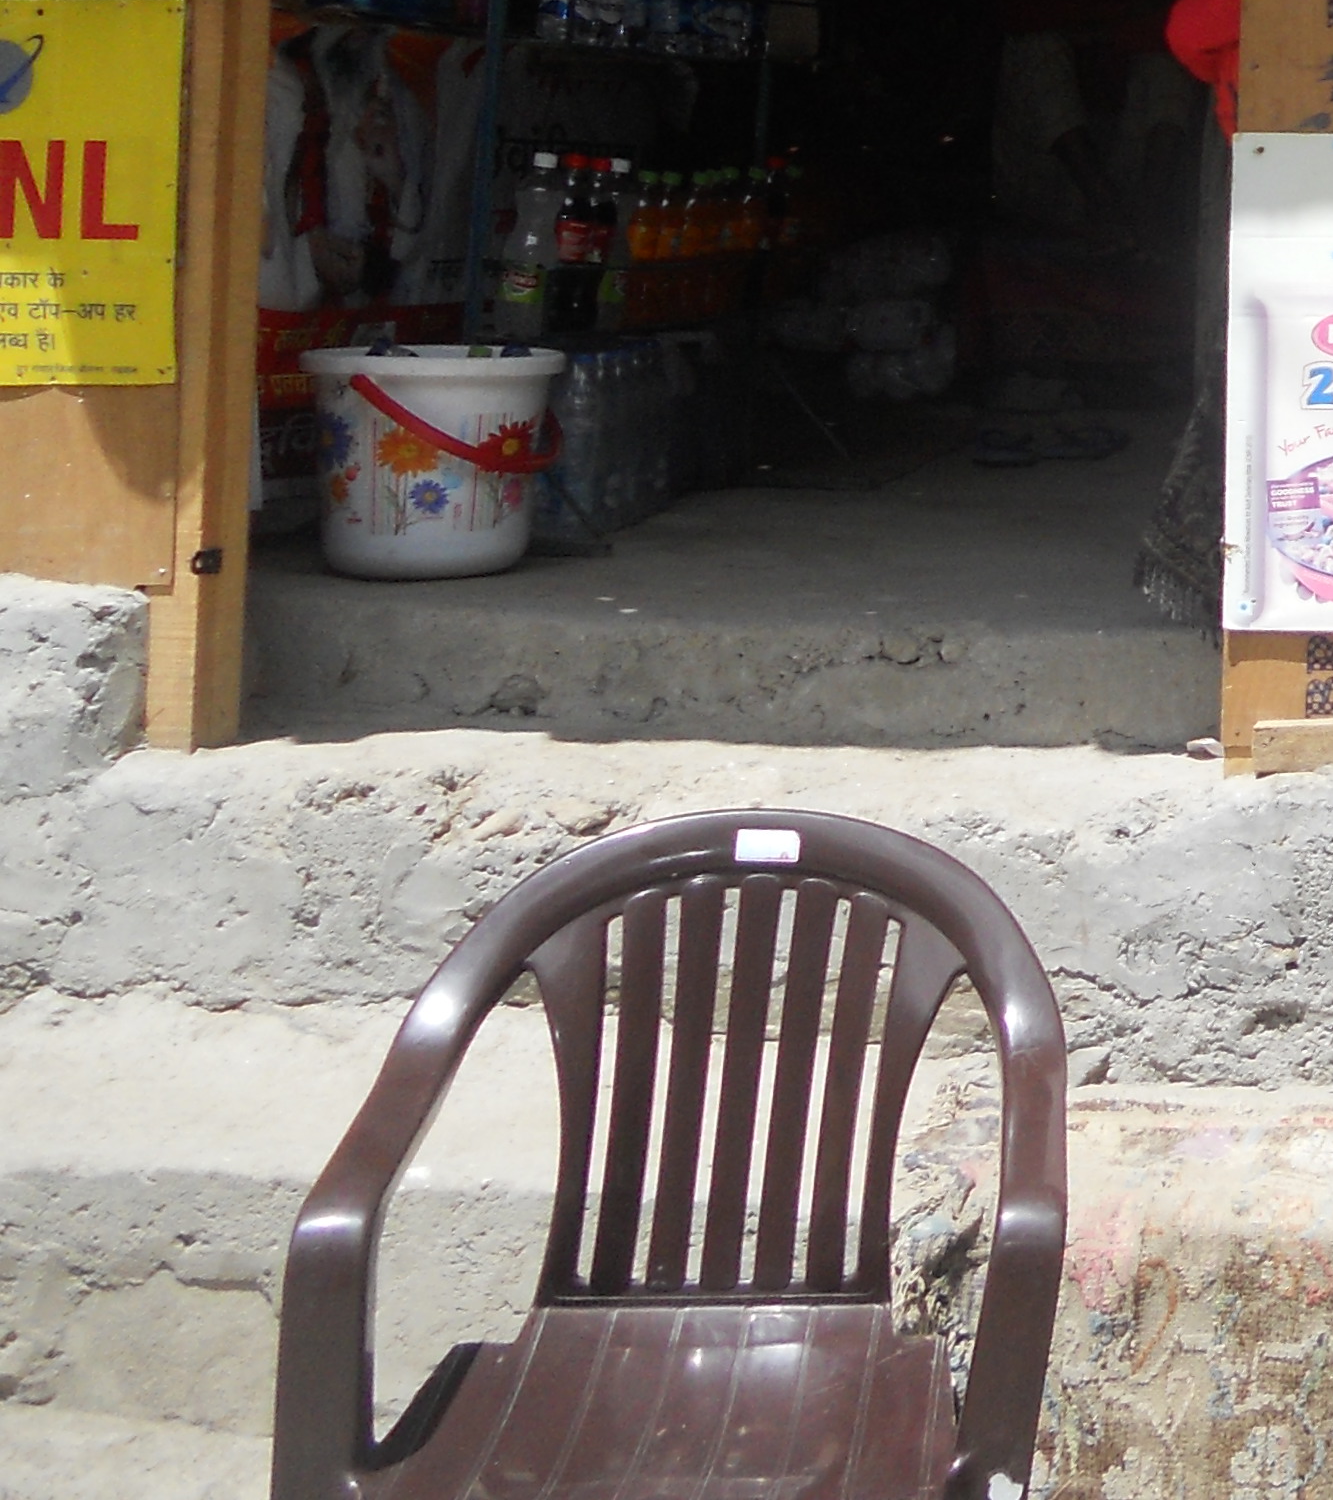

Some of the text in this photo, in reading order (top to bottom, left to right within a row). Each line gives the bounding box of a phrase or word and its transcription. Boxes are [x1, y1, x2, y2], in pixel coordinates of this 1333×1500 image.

[0, 267, 66, 288] कार के
[113, 304, 137, 322] हर
[1277, 433, 1311, 457] Your
